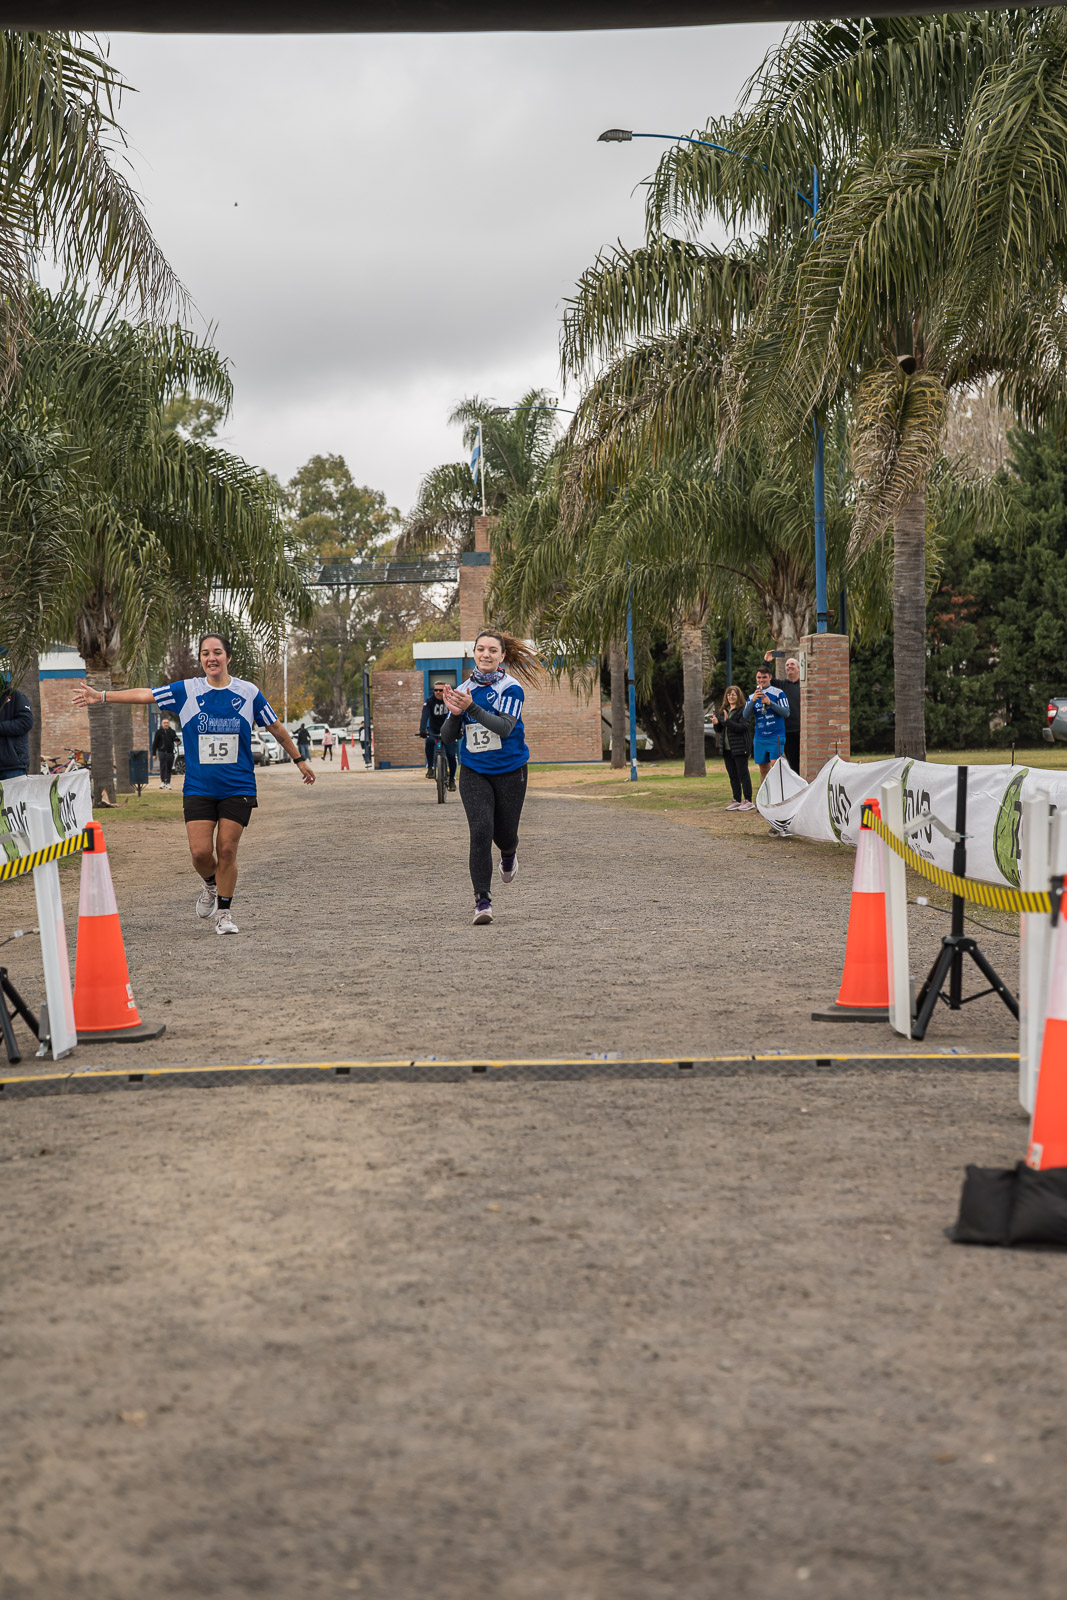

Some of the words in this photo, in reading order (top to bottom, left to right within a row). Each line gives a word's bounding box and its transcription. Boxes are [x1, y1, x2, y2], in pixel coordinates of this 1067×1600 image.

[198, 712, 208, 733] 3
[472, 731, 490, 746] 13
[208, 742, 229, 757] 15
